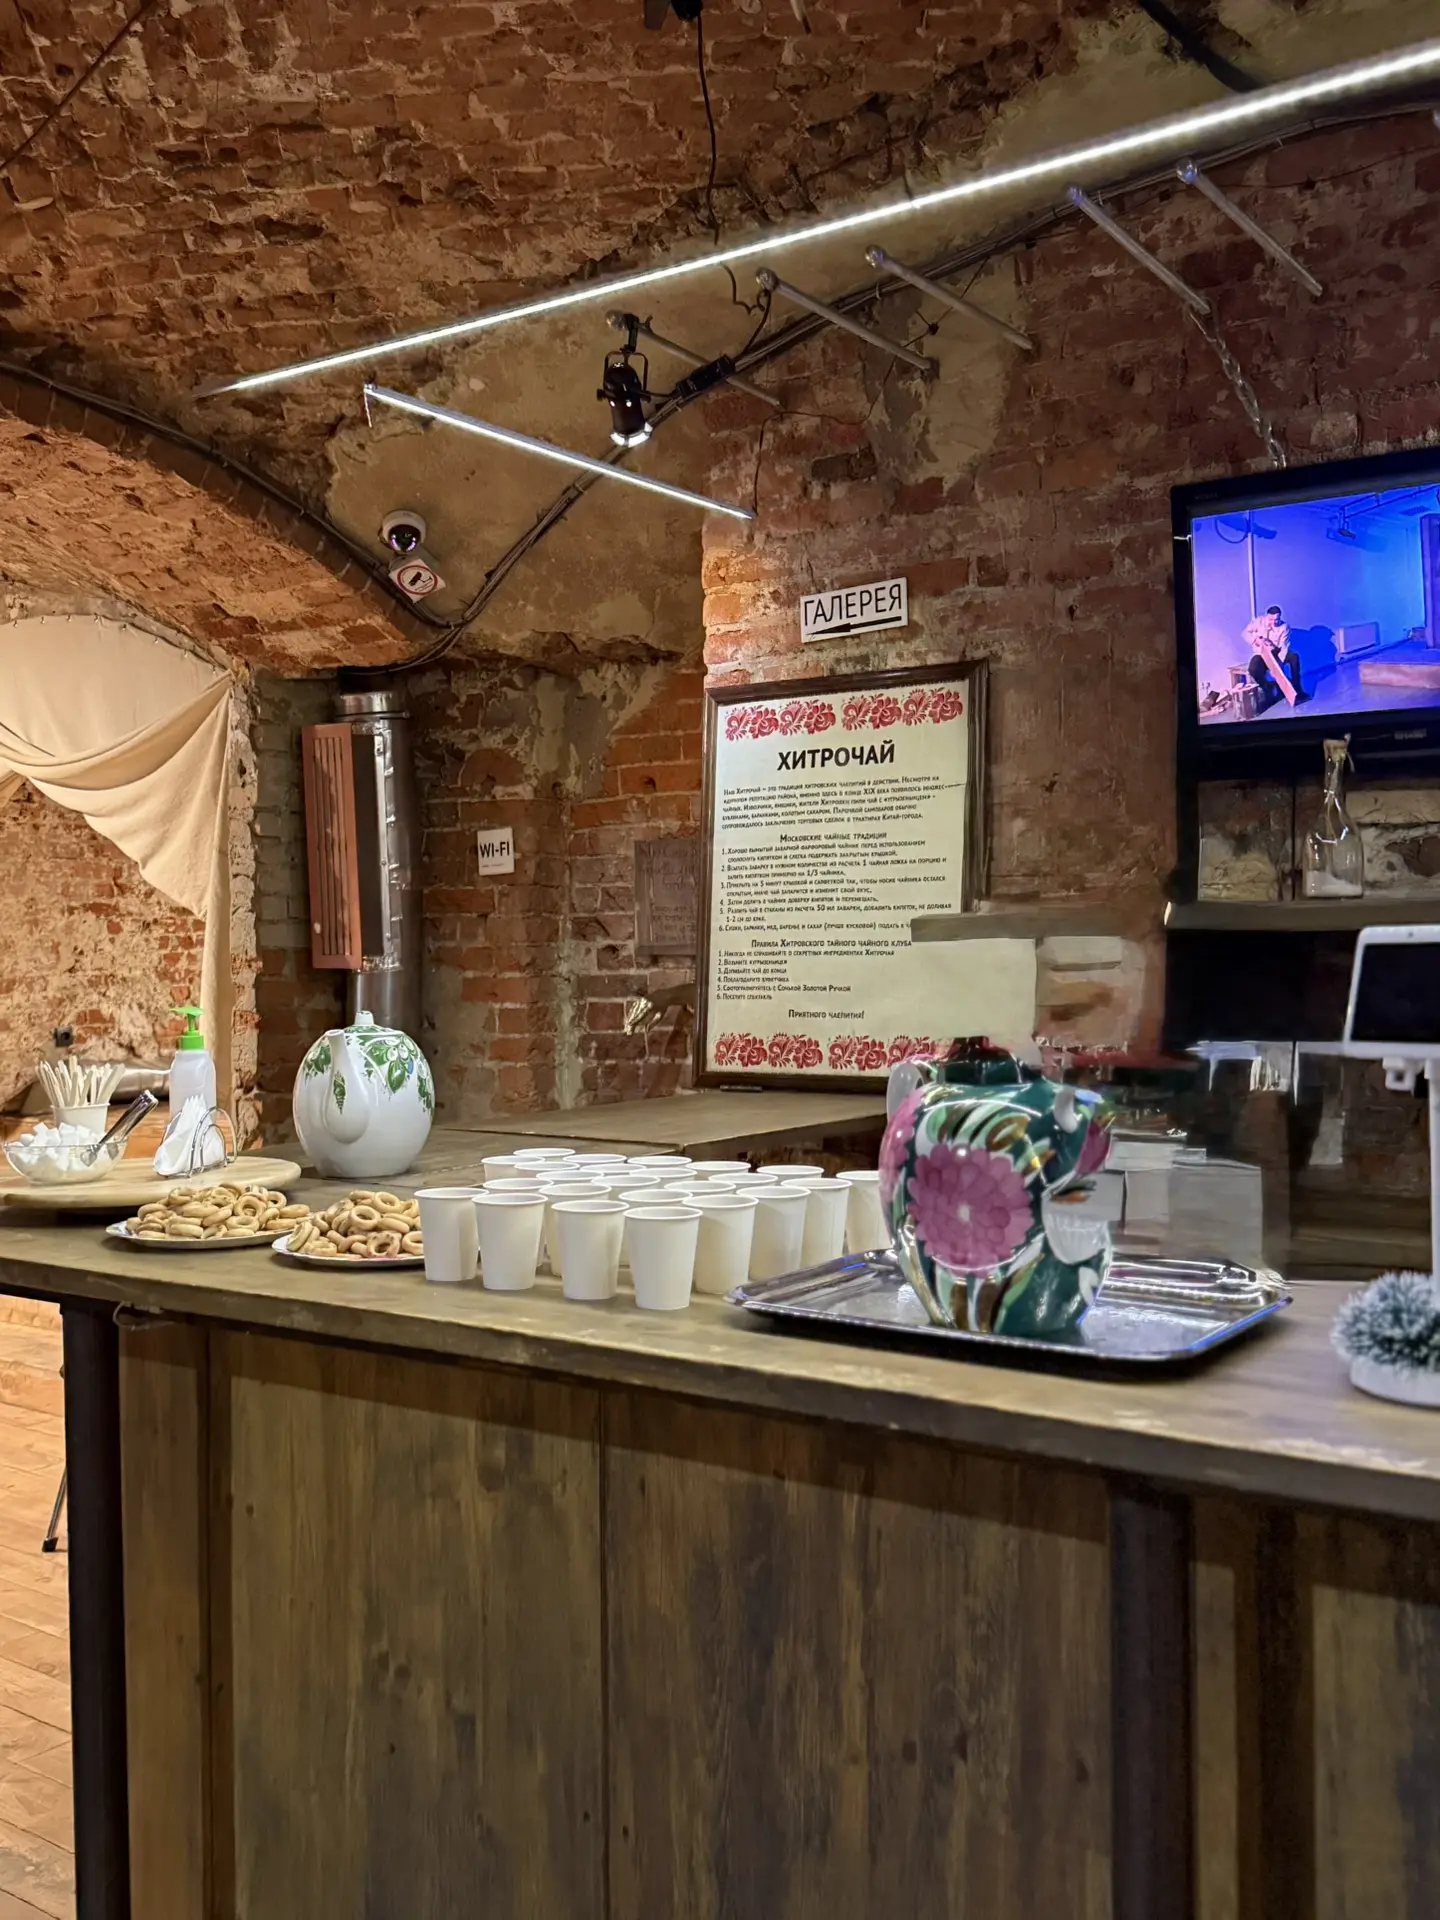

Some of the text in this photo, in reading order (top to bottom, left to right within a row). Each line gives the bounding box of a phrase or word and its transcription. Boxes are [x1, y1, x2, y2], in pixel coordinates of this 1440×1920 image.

[804, 583, 902, 627] ГАЛЕРЕЯ
[777, 739, 895, 771] ХИТРОЧАЙ
[824, 833, 851, 841] чайные
[853, 833, 887, 841] традиции
[479, 841, 510, 858] WI-FI
[752, 939, 779, 948] Правила
[781, 939, 824, 947] Хитровского
[827, 939, 856, 947] тайного
[858, 939, 889, 947] чайного
[789, 1010, 865, 1019] Приятного чаепития!
